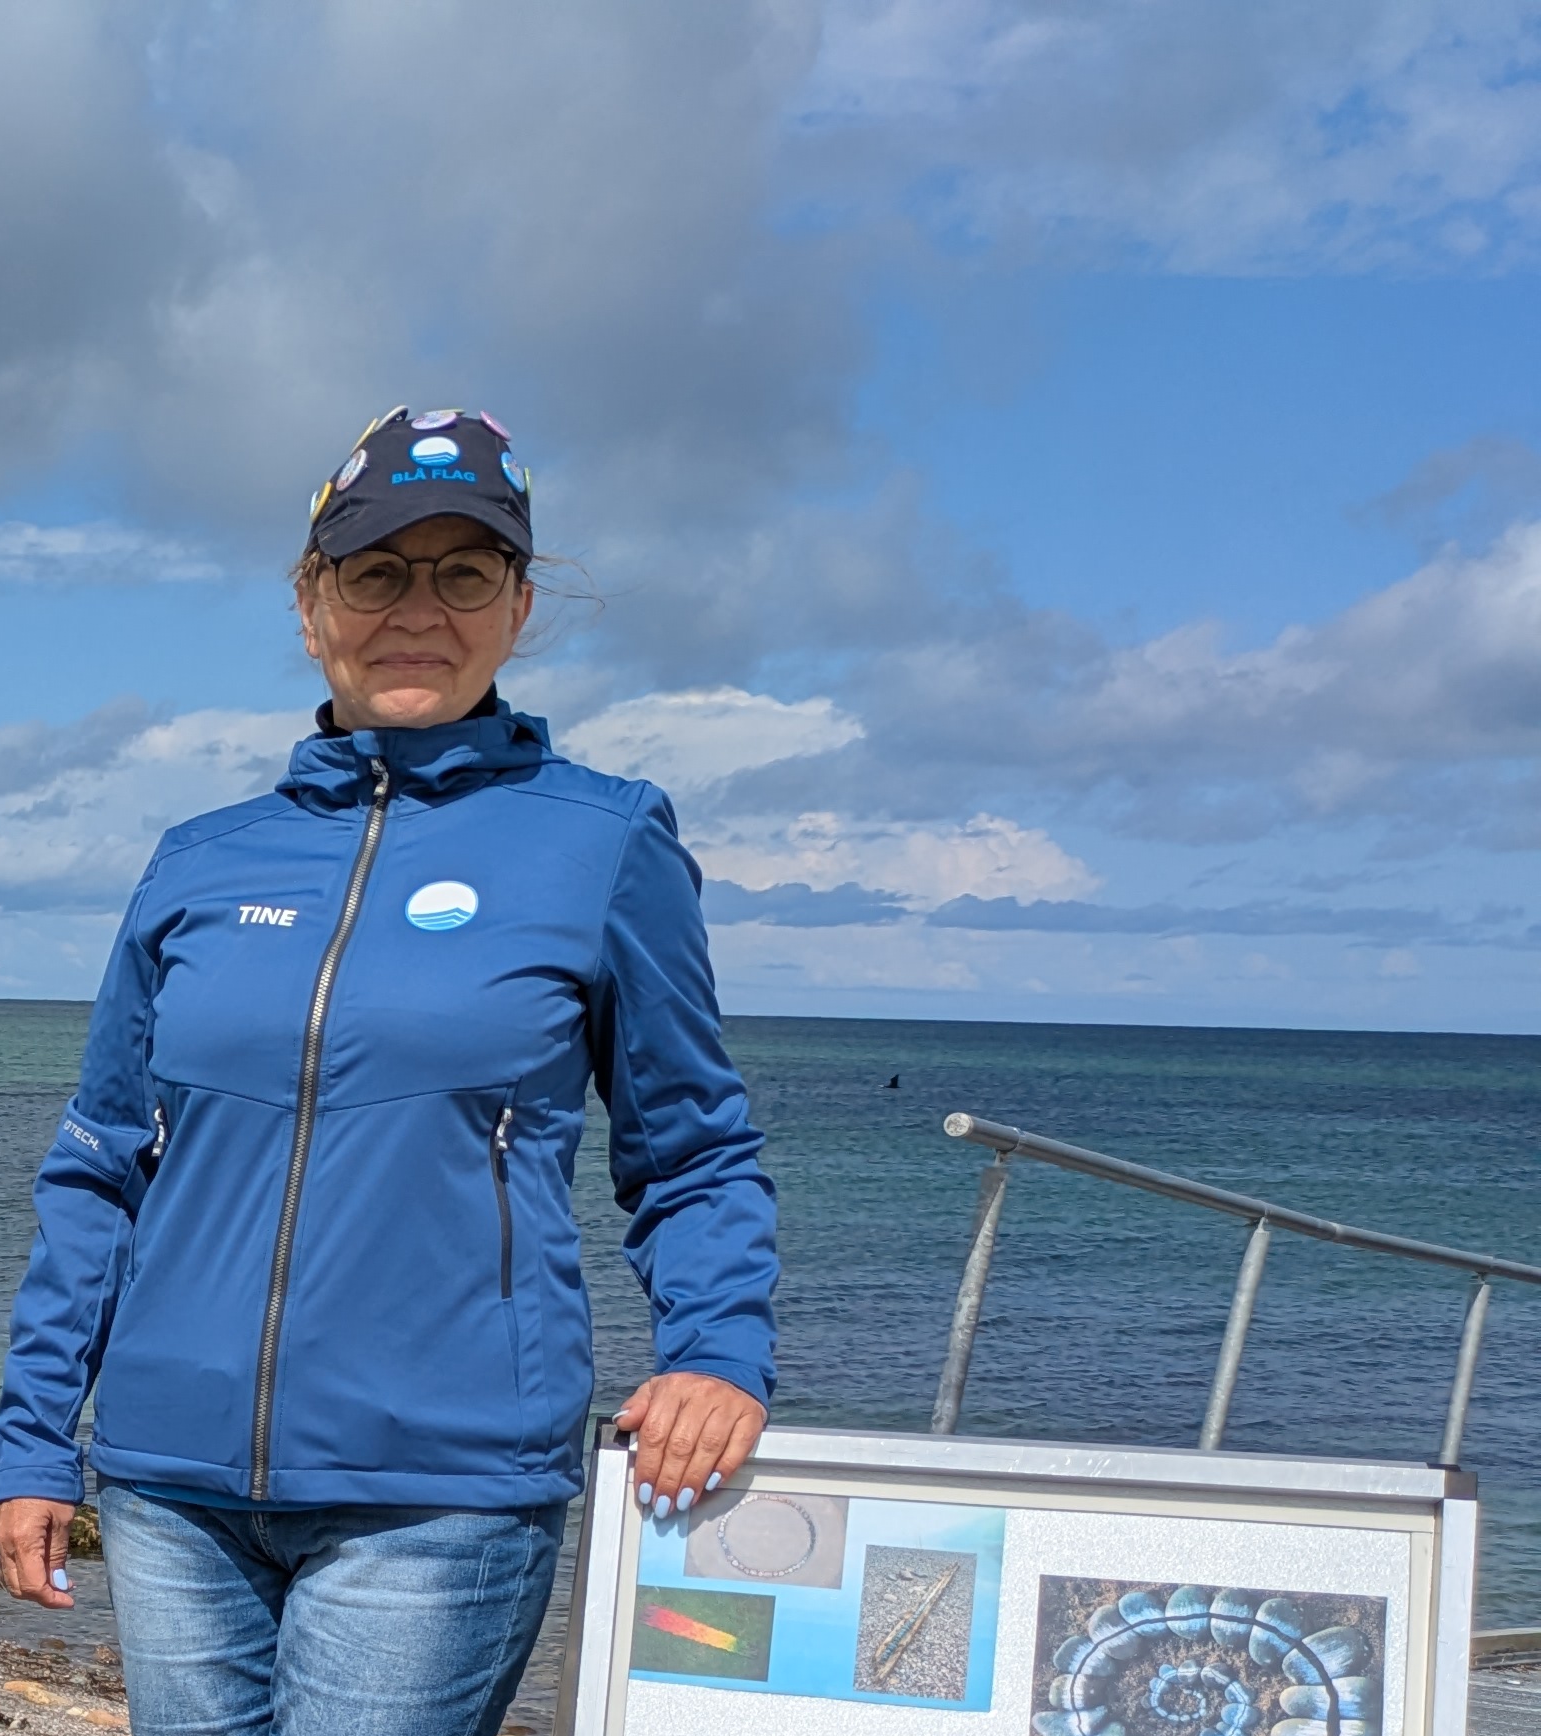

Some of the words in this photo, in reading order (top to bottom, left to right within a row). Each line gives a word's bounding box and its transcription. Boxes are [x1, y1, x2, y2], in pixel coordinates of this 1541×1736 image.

[391, 467, 427, 484] BLÅ
[431, 469, 478, 483] FLAG
[239, 905, 298, 927] TINE
